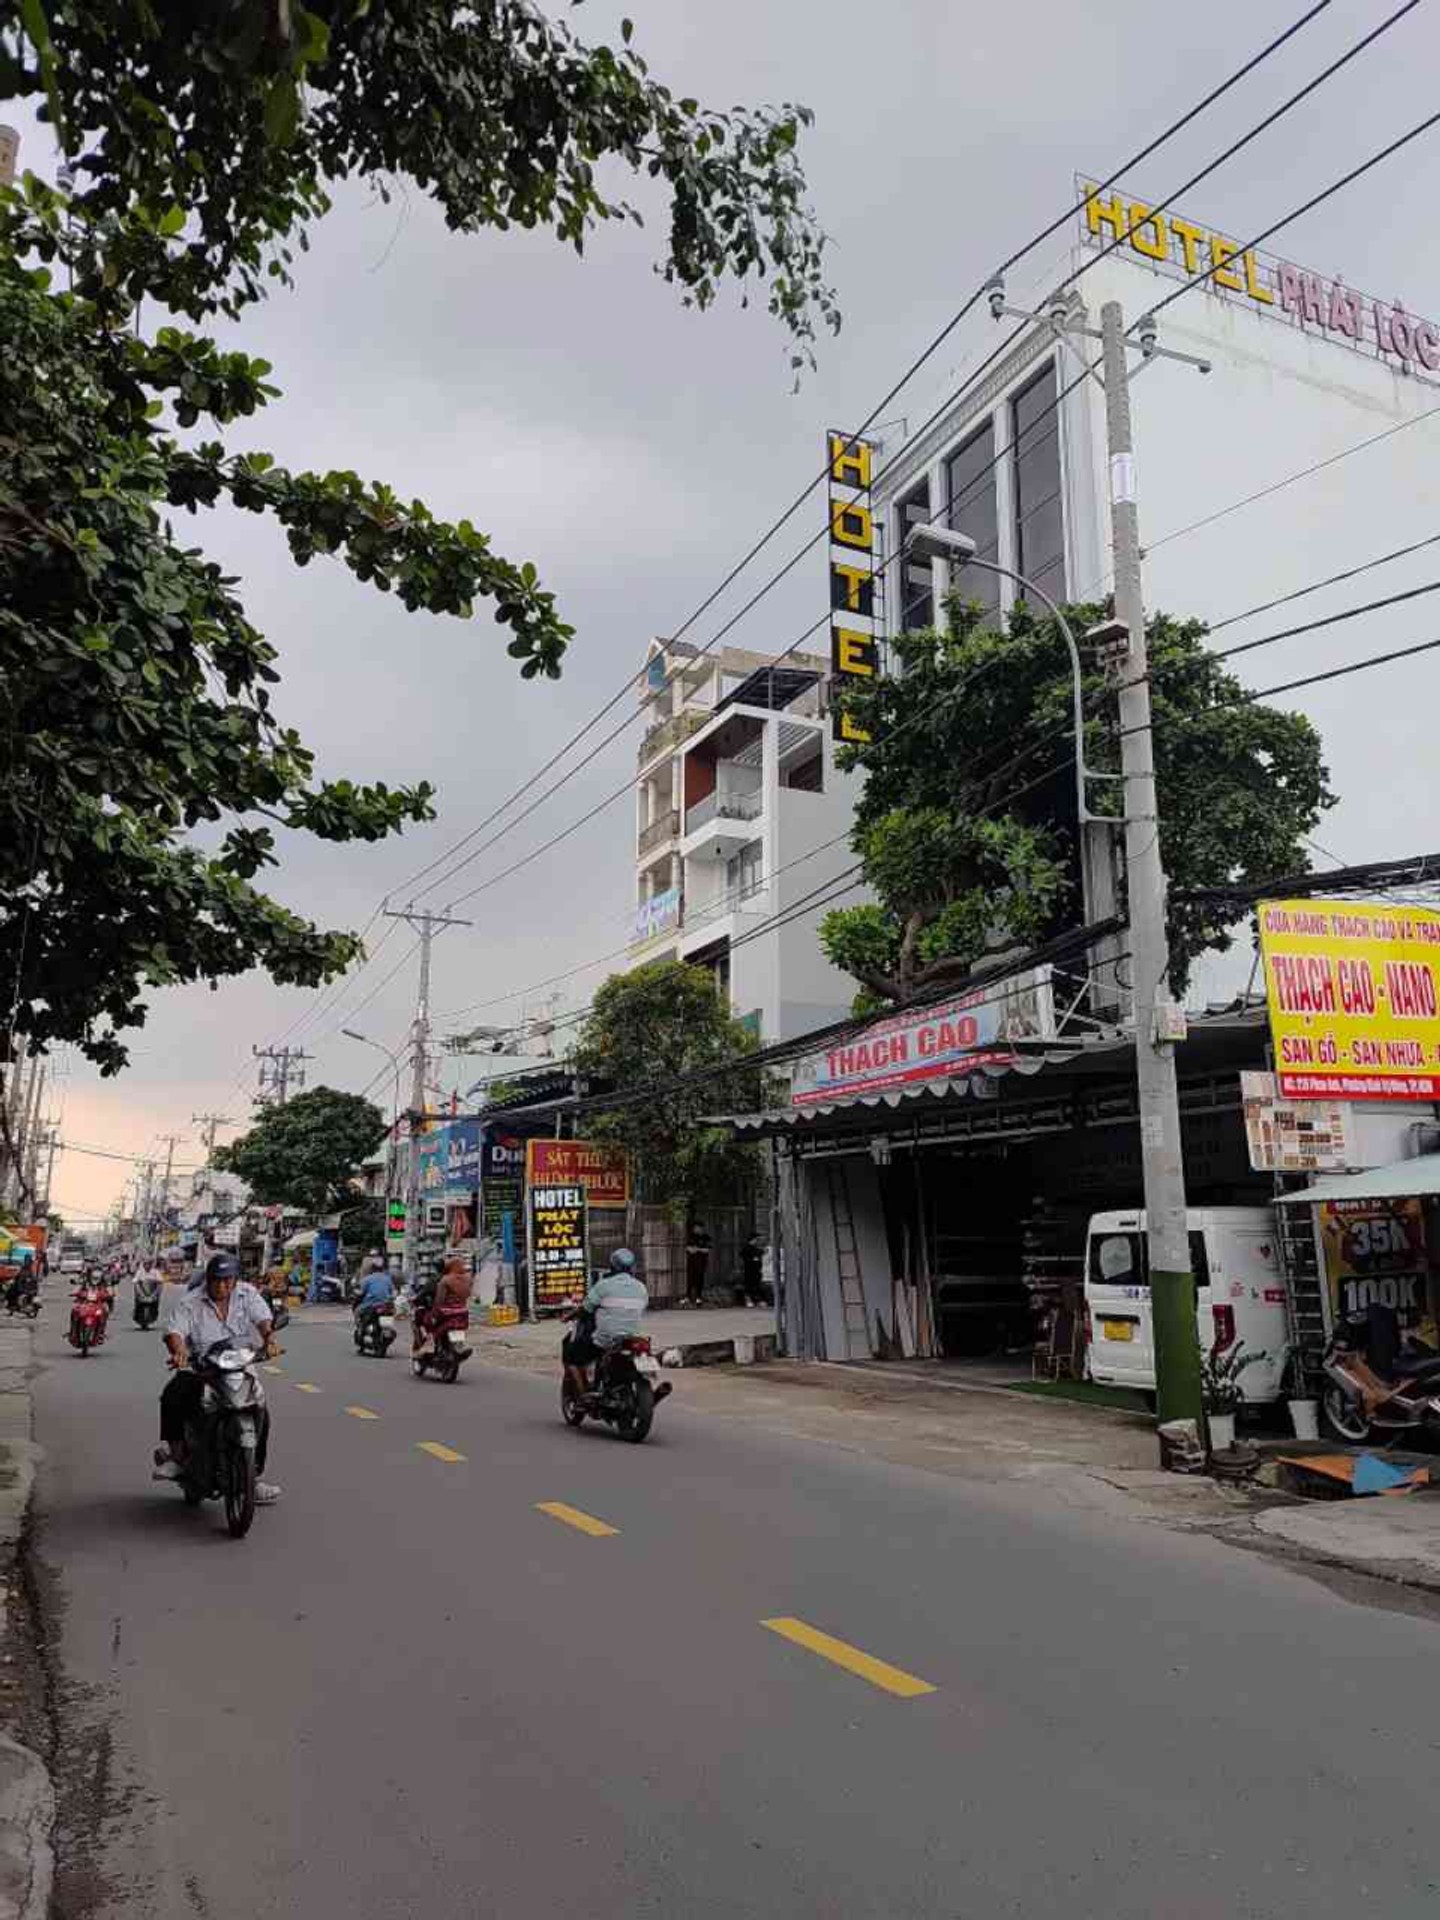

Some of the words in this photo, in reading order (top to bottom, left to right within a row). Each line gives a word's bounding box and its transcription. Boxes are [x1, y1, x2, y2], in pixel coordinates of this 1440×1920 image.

[1083, 182, 1274, 305] HOTEL
[1271, 954, 1337, 1026] THẠCH
[1337, 957, 1376, 1016] CAO
[1385, 961, 1438, 1019] NANO
[916, 1015, 979, 1057] CAO
[534, 1188, 583, 1208] HOTEL
[1351, 1217, 1410, 1255] 35K
[1344, 1277, 1417, 1312] 100K
